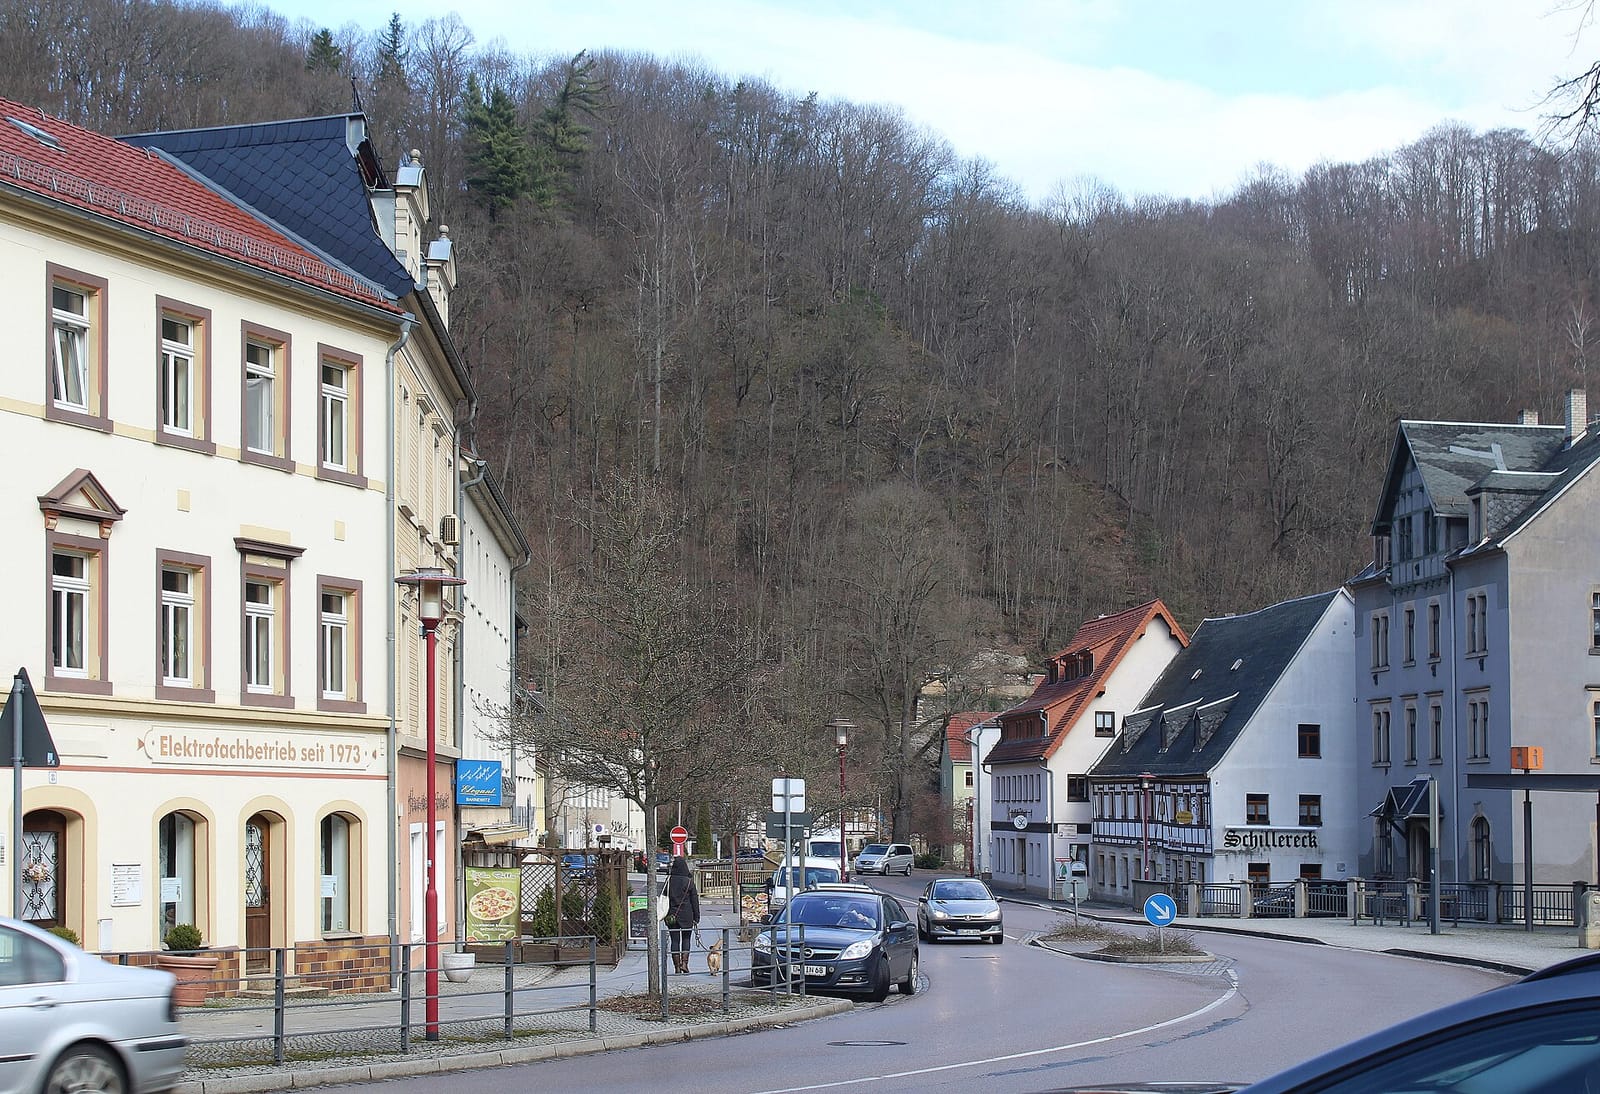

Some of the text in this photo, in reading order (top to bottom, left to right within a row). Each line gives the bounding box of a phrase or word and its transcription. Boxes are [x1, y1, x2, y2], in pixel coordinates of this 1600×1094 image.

[160, 735, 361, 763] Elektrofachbetrieb seit 1973
[1224, 830, 1318, 850] Schillereck
